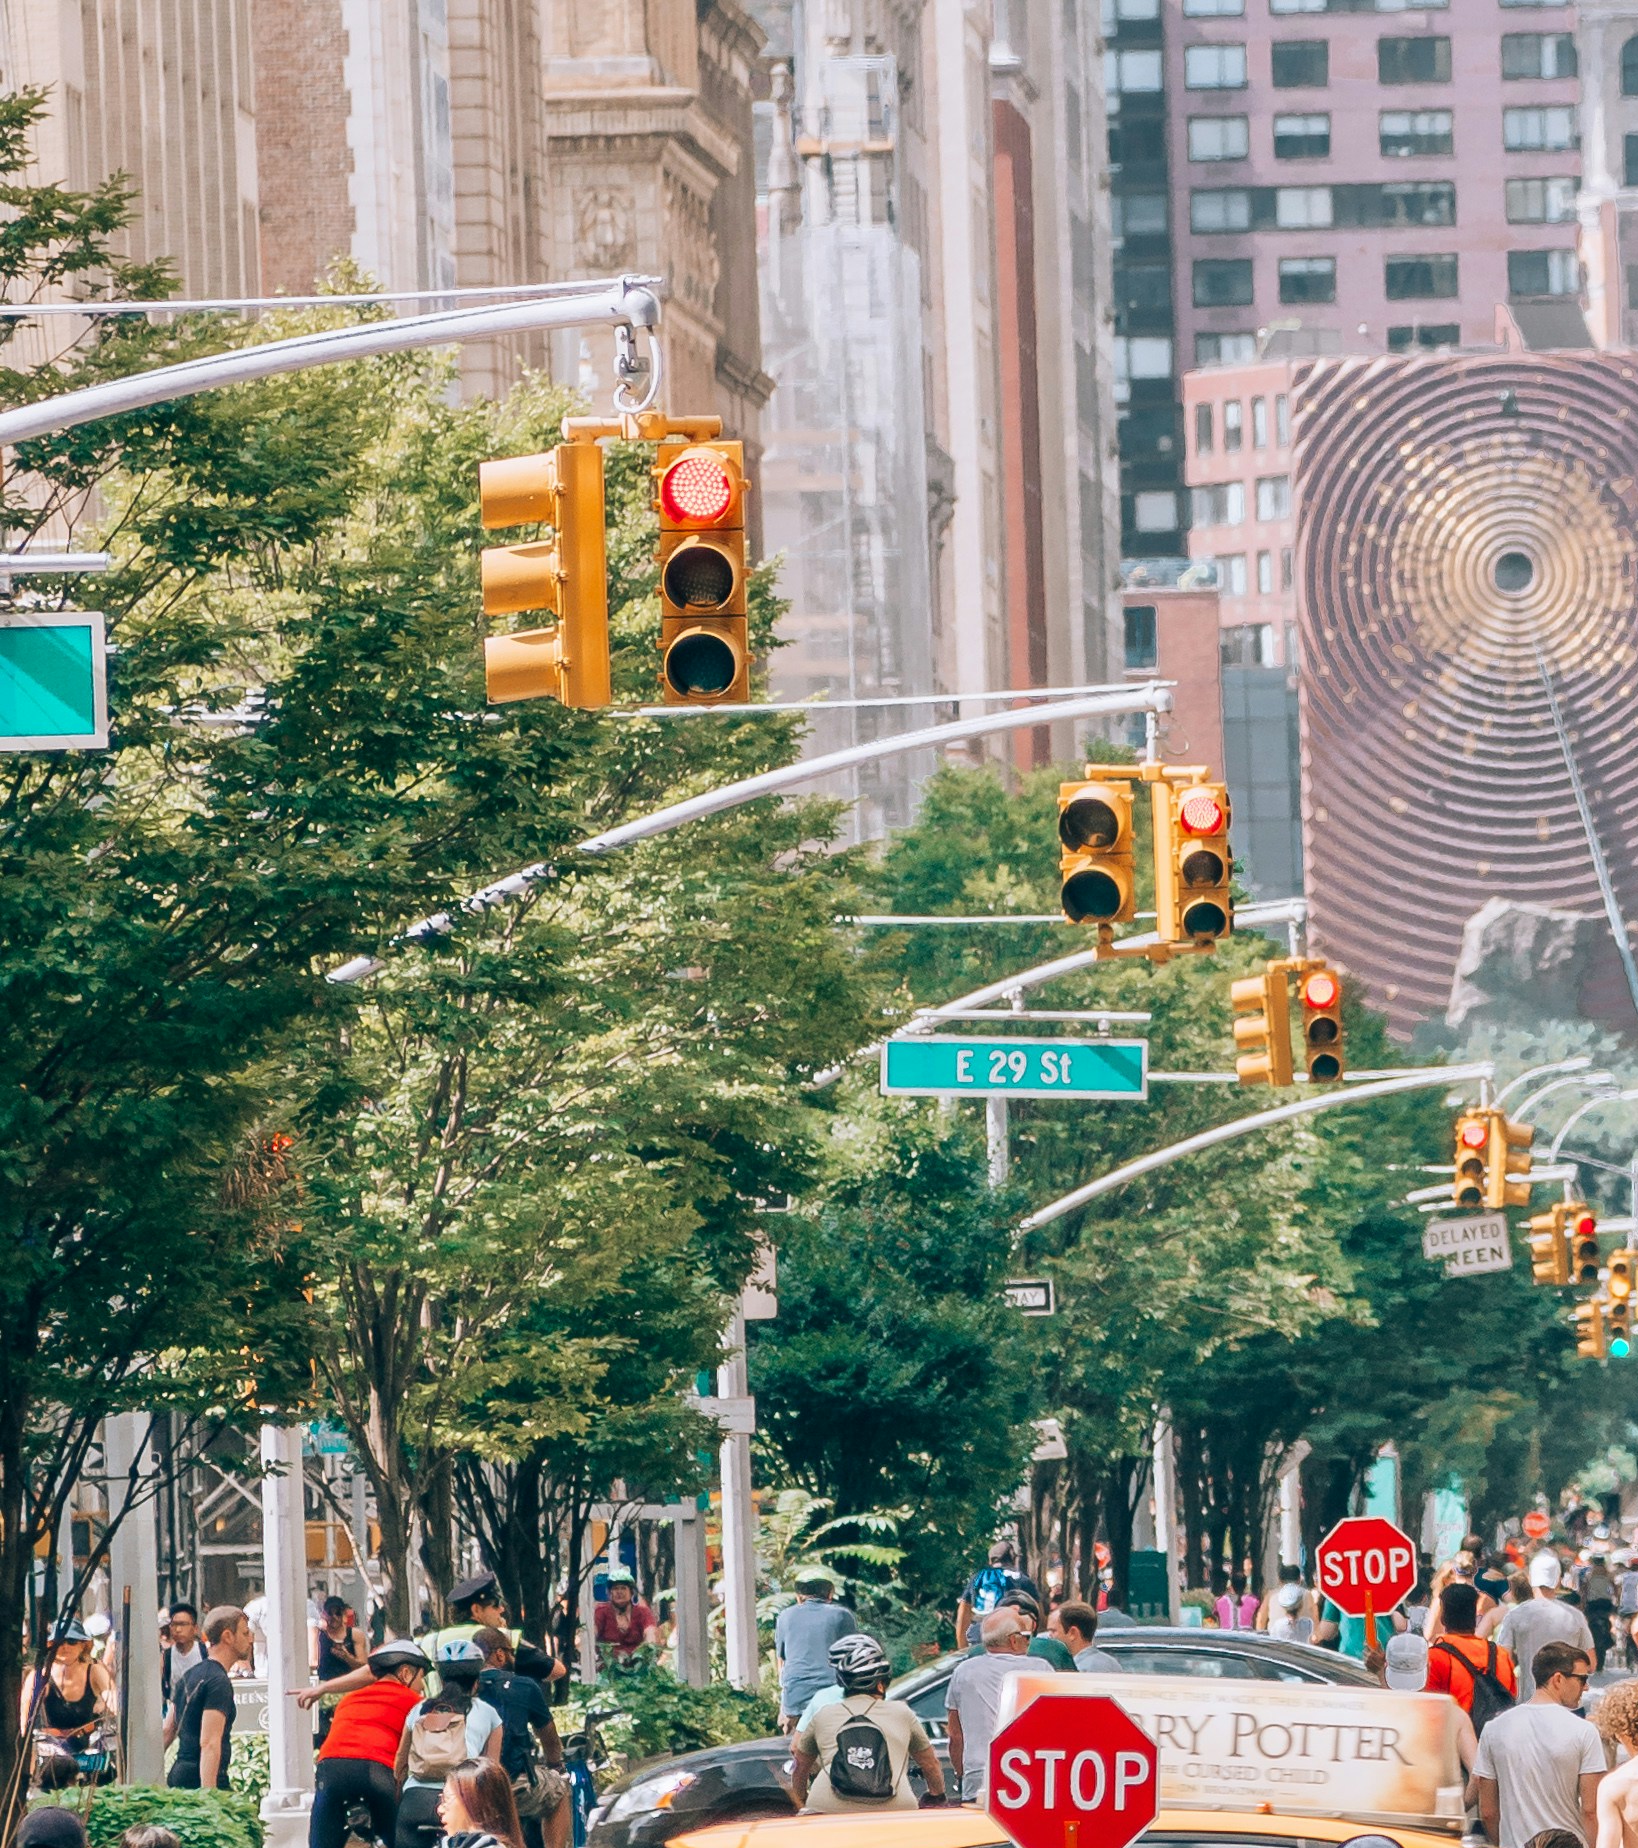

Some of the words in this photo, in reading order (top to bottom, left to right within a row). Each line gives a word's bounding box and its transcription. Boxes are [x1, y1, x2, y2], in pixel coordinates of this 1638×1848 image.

[957, 1050, 974, 1083] E
[988, 1050, 1027, 1084] 29
[1040, 1051, 1073, 1085] St
[1429, 1223, 1499, 1247] DELAYED
[1446, 1246, 1504, 1267] REEN
[1323, 1547, 1410, 1587] STOP
[1228, 1712, 1414, 1767] POTTER
[997, 1748, 1150, 1811] STOP
[1183, 1762, 1260, 1782] CURSED
[1265, 1767, 1331, 1785] CHILD
